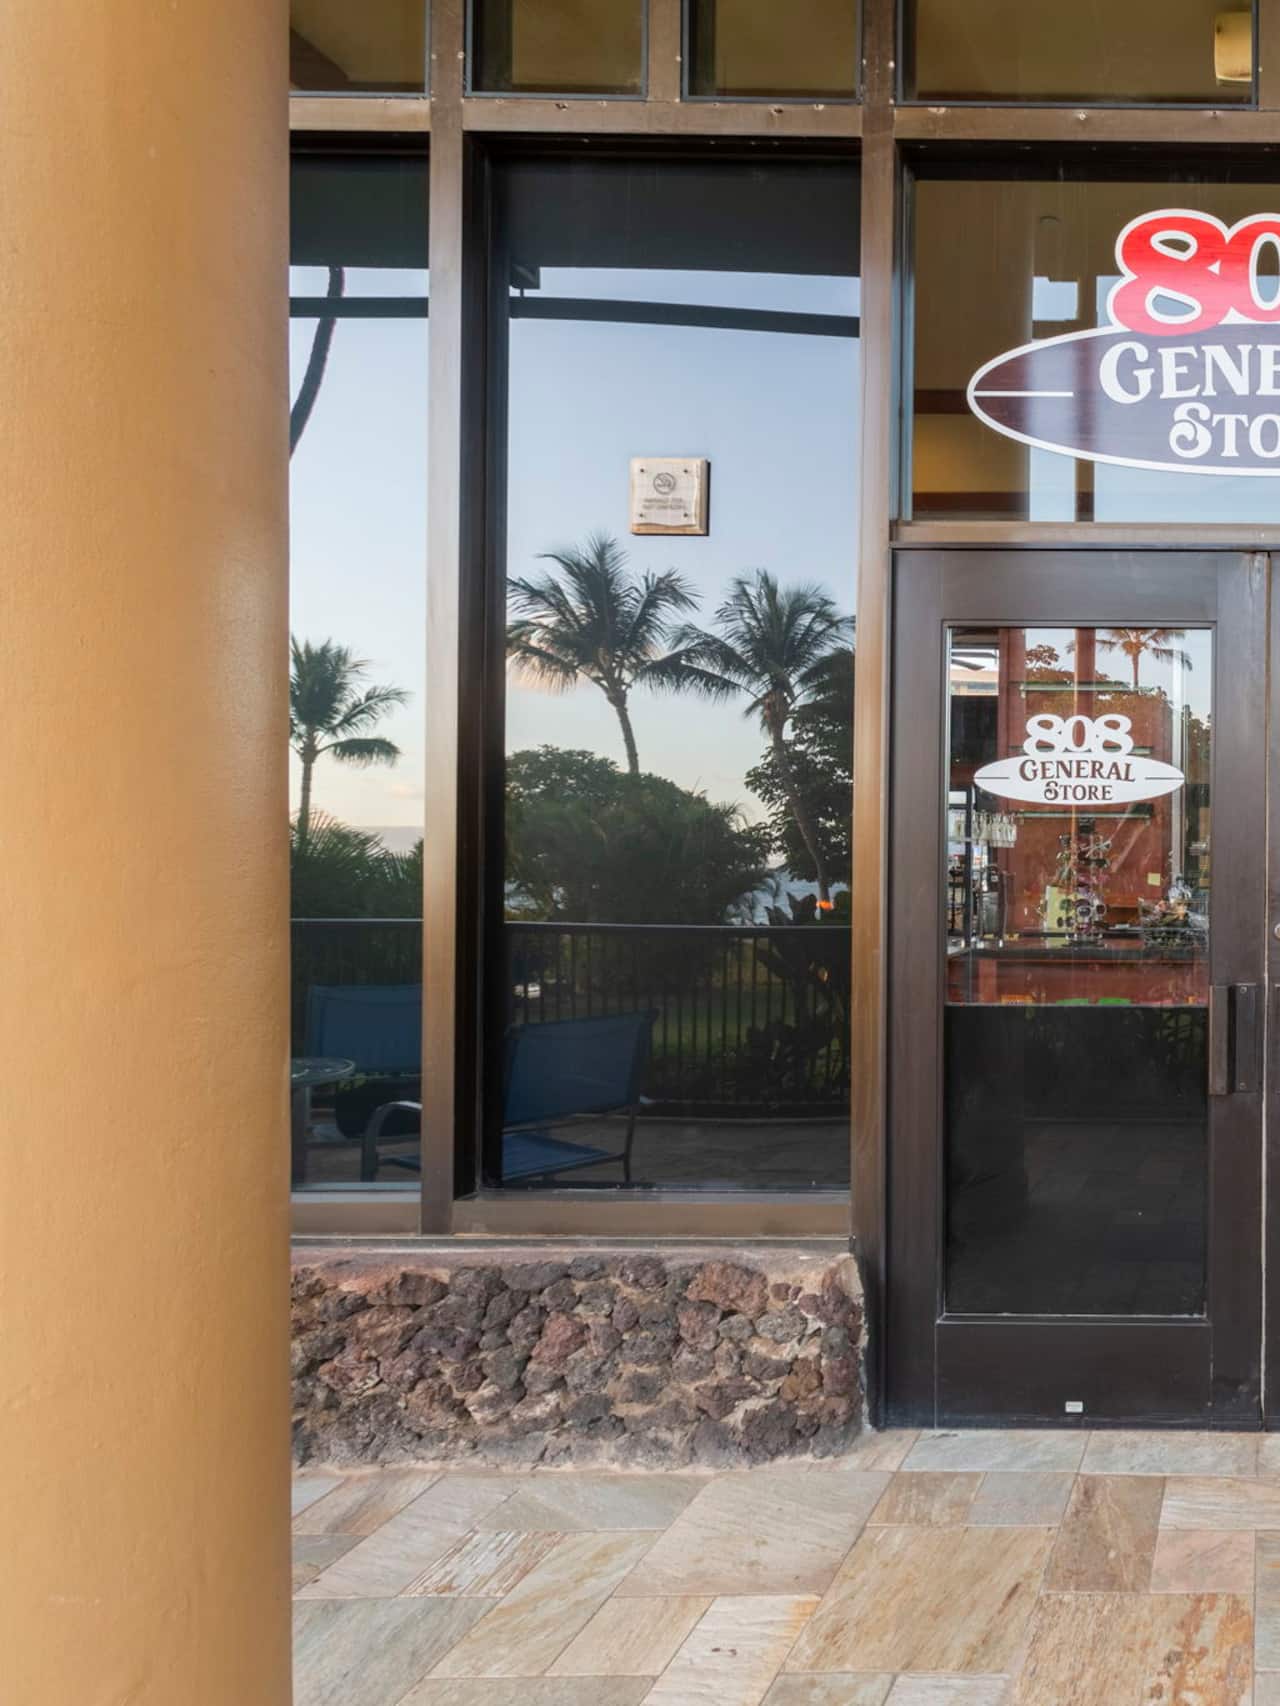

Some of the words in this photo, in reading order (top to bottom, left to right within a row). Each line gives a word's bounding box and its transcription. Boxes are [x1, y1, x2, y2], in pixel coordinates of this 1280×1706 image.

[1023, 713, 1134, 755] 808
[1018, 759, 1136, 782] GENERAL
[1043, 780, 1113, 801] STORE
